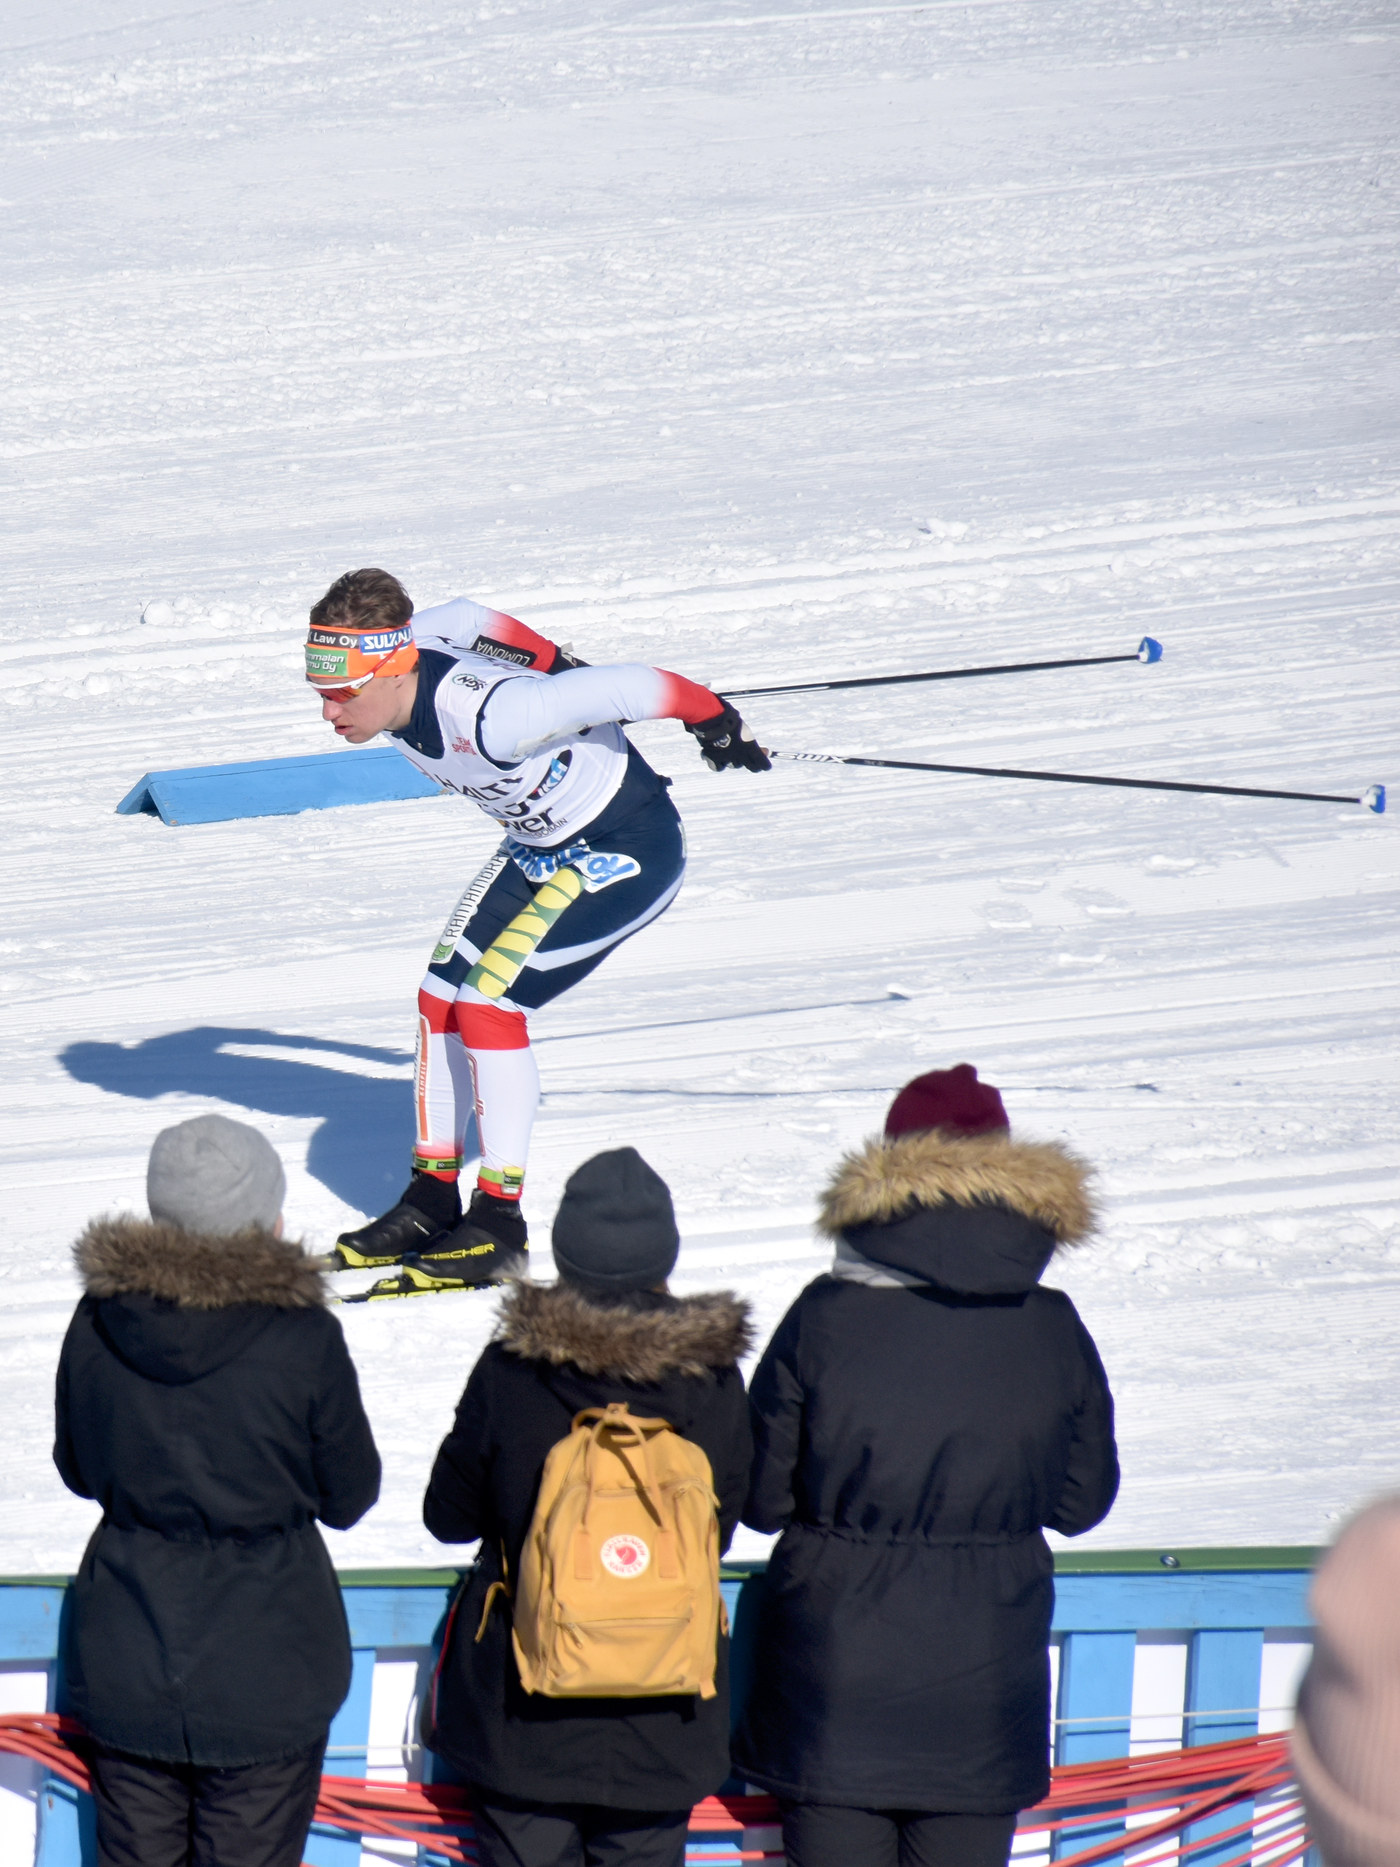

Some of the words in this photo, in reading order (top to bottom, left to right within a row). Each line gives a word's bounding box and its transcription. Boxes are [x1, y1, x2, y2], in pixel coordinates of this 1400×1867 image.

[313, 631, 336, 645] Law
[339, 635, 358, 648] Oy
[322, 661, 337, 673] Oy
[434, 774, 524, 801] HALTY
